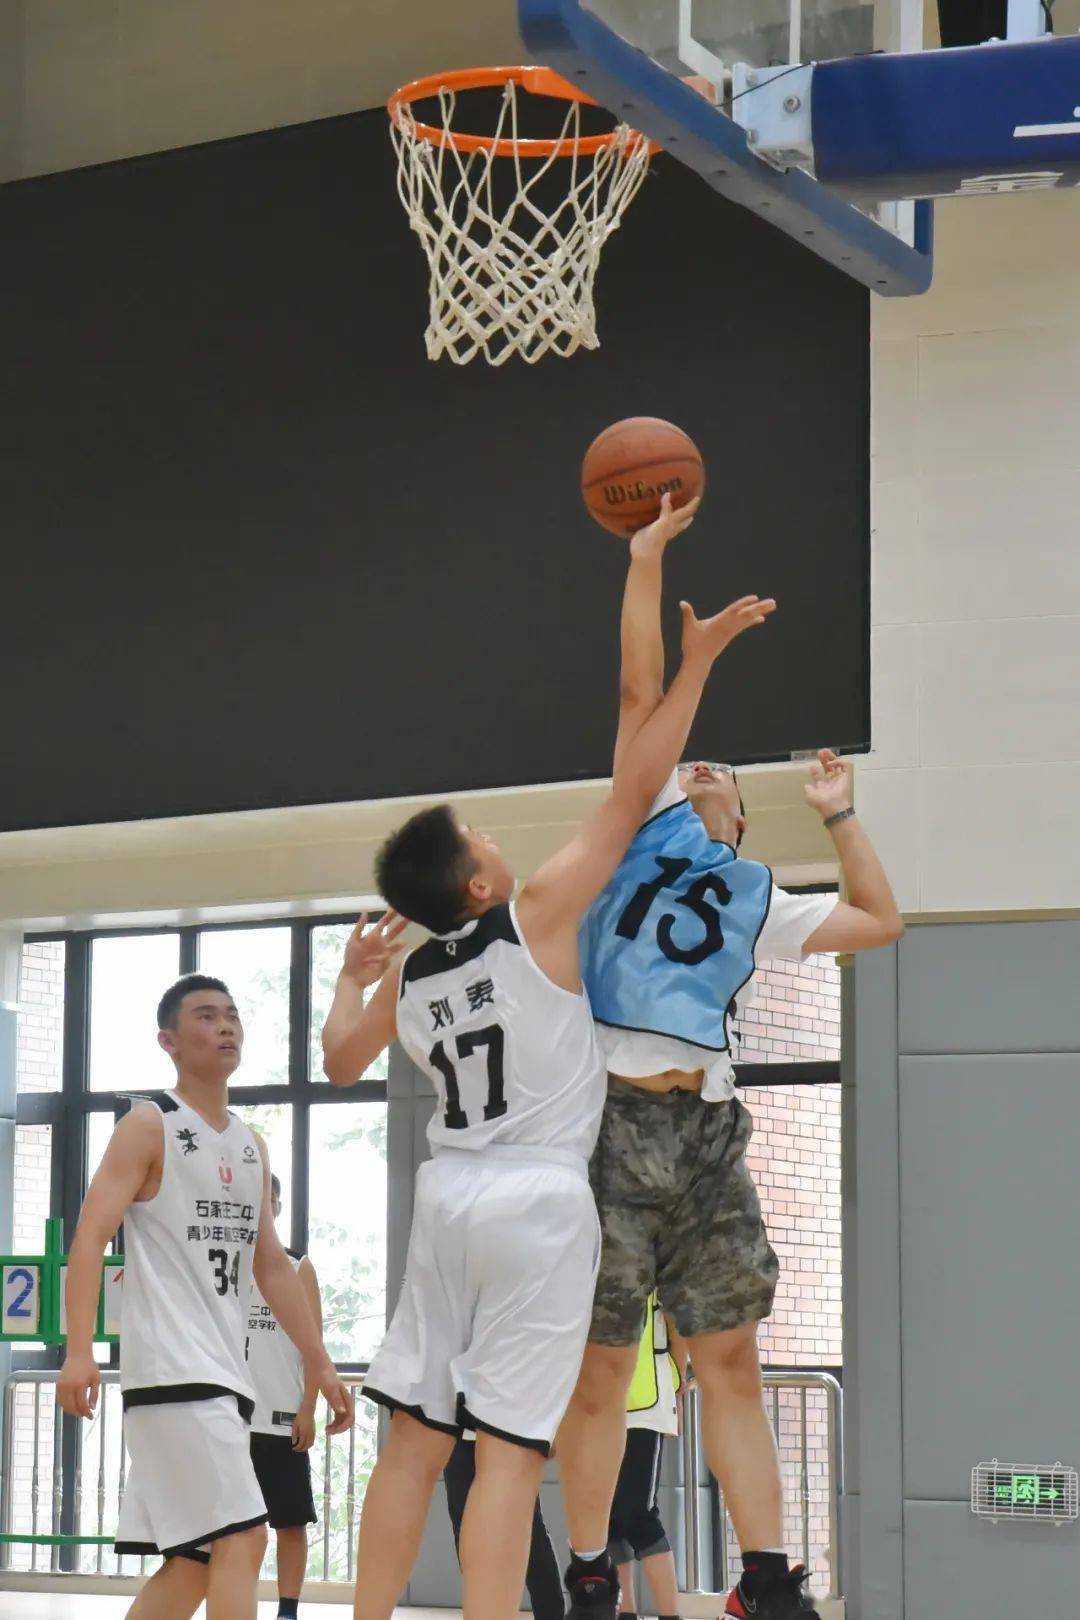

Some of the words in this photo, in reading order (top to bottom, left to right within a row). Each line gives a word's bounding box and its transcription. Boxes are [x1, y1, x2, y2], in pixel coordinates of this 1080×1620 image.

[604, 477, 683, 505] Wilson
[429, 1023, 508, 1129] 17
[195, 1200, 254, 1221] 石家庄二中
[7, 1268, 34, 1317] 2
